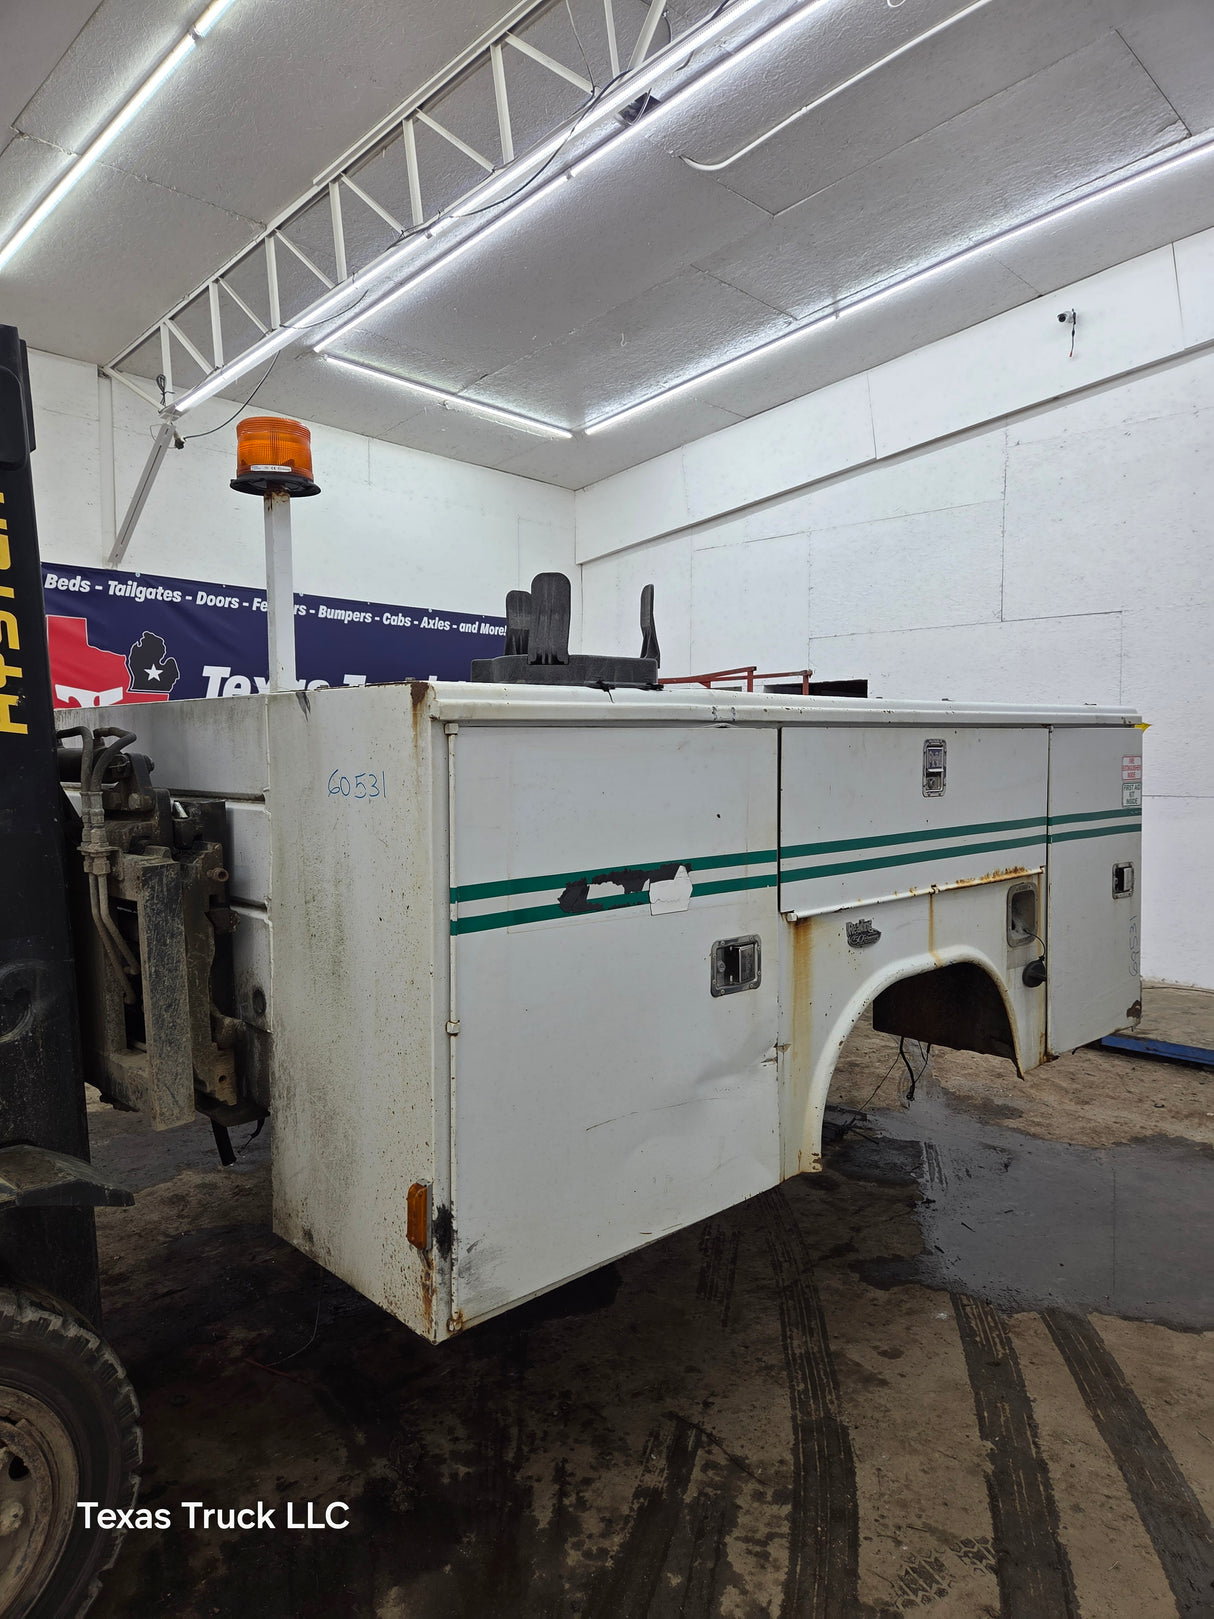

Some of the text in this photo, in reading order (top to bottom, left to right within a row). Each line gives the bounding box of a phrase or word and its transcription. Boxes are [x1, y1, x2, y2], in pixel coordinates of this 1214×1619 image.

[44, 573, 91, 593] Beds
[107, 580, 182, 603] Tailgates
[195, 591, 240, 609] Doors
[252, 597, 307, 616] Fers
[317, 604, 373, 624] Bumpers
[382, 612, 412, 627] Cabs
[419, 616, 451, 631] Axles
[458, 621, 479, 633] and
[480, 622, 507, 636] More!
[327, 769, 386, 799] 60531
